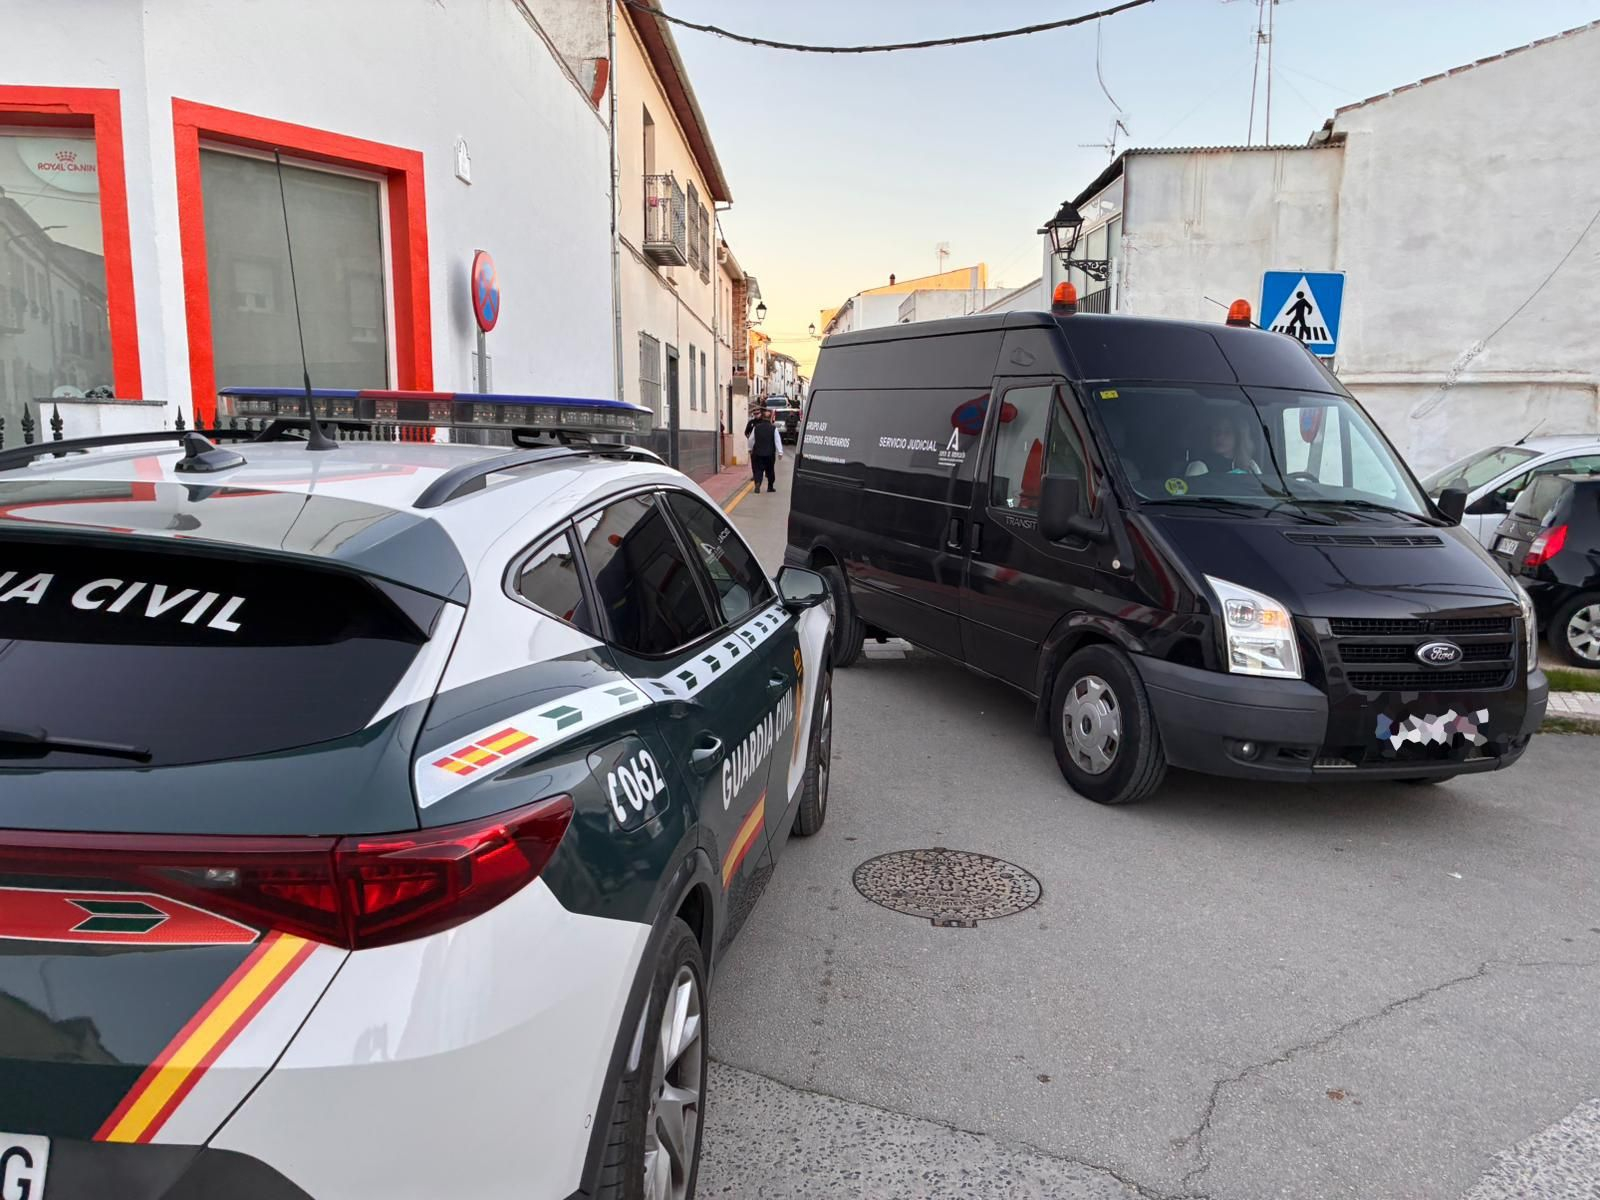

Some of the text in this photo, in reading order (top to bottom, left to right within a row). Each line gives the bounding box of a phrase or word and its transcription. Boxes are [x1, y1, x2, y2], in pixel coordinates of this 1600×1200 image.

[37, 162, 96, 173] ROYAL CANIN
[823, 436, 850, 448] FUNERARIOS
[879, 436, 937, 452] SERVICIO JUDICIAL
[71, 578, 246, 632] CIVIL
[1430, 646, 1455, 660] Ford
[722, 687, 793, 811] GUARDIA CIVIL
